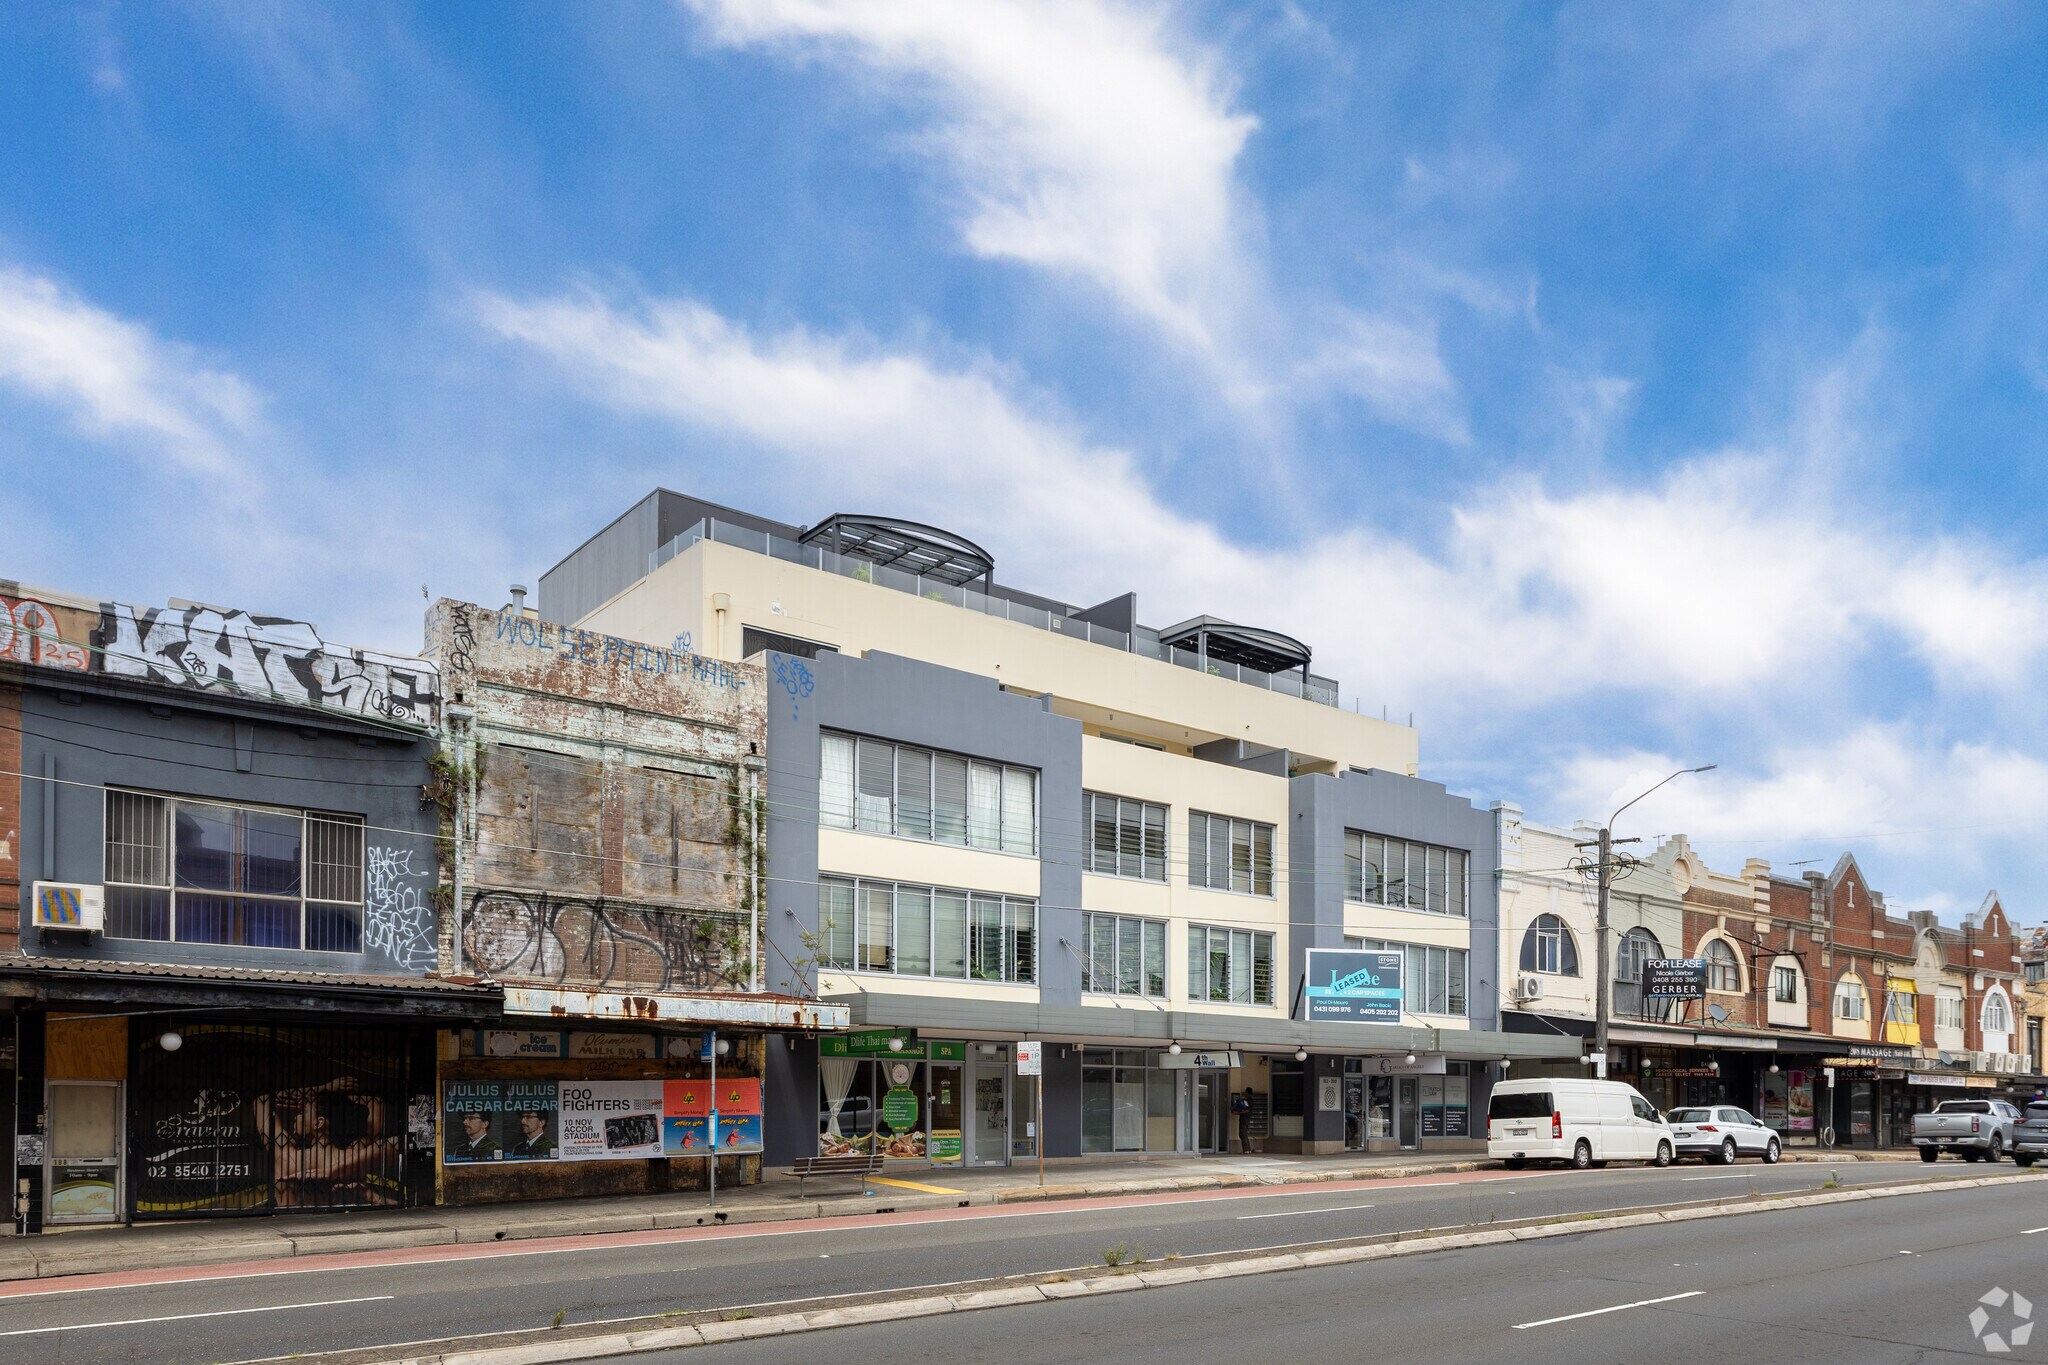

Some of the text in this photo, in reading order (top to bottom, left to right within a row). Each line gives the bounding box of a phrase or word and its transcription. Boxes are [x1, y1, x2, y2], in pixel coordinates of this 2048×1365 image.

[1648, 959, 1702, 969] FOR LEASE
[1334, 972, 1366, 992] LEASED
[1652, 985, 1697, 994] GERBER
[529, 1032, 548, 1045] ice
[867, 1035, 881, 1046] Thai
[519, 1044, 557, 1053] cream
[578, 1046, 614, 1055] MILK
[940, 1047, 952, 1056] SPA
[1860, 1047, 1892, 1057] MASSAGE
[448, 1084, 500, 1097] JULIUS
[506, 1084, 556, 1096] JULIUS
[563, 1088, 592, 1100] FOO
[683, 1095, 695, 1104] up
[728, 1094, 740, 1103] up
[445, 1100, 503, 1112] CAESAR
[504, 1100, 559, 1111] CAESAR
[563, 1099, 630, 1111] FIGHTERS
[564, 1125, 594, 1133] ACCOR
[564, 1132, 600, 1140] STADIUM
[148, 1165, 167, 1178] 02
